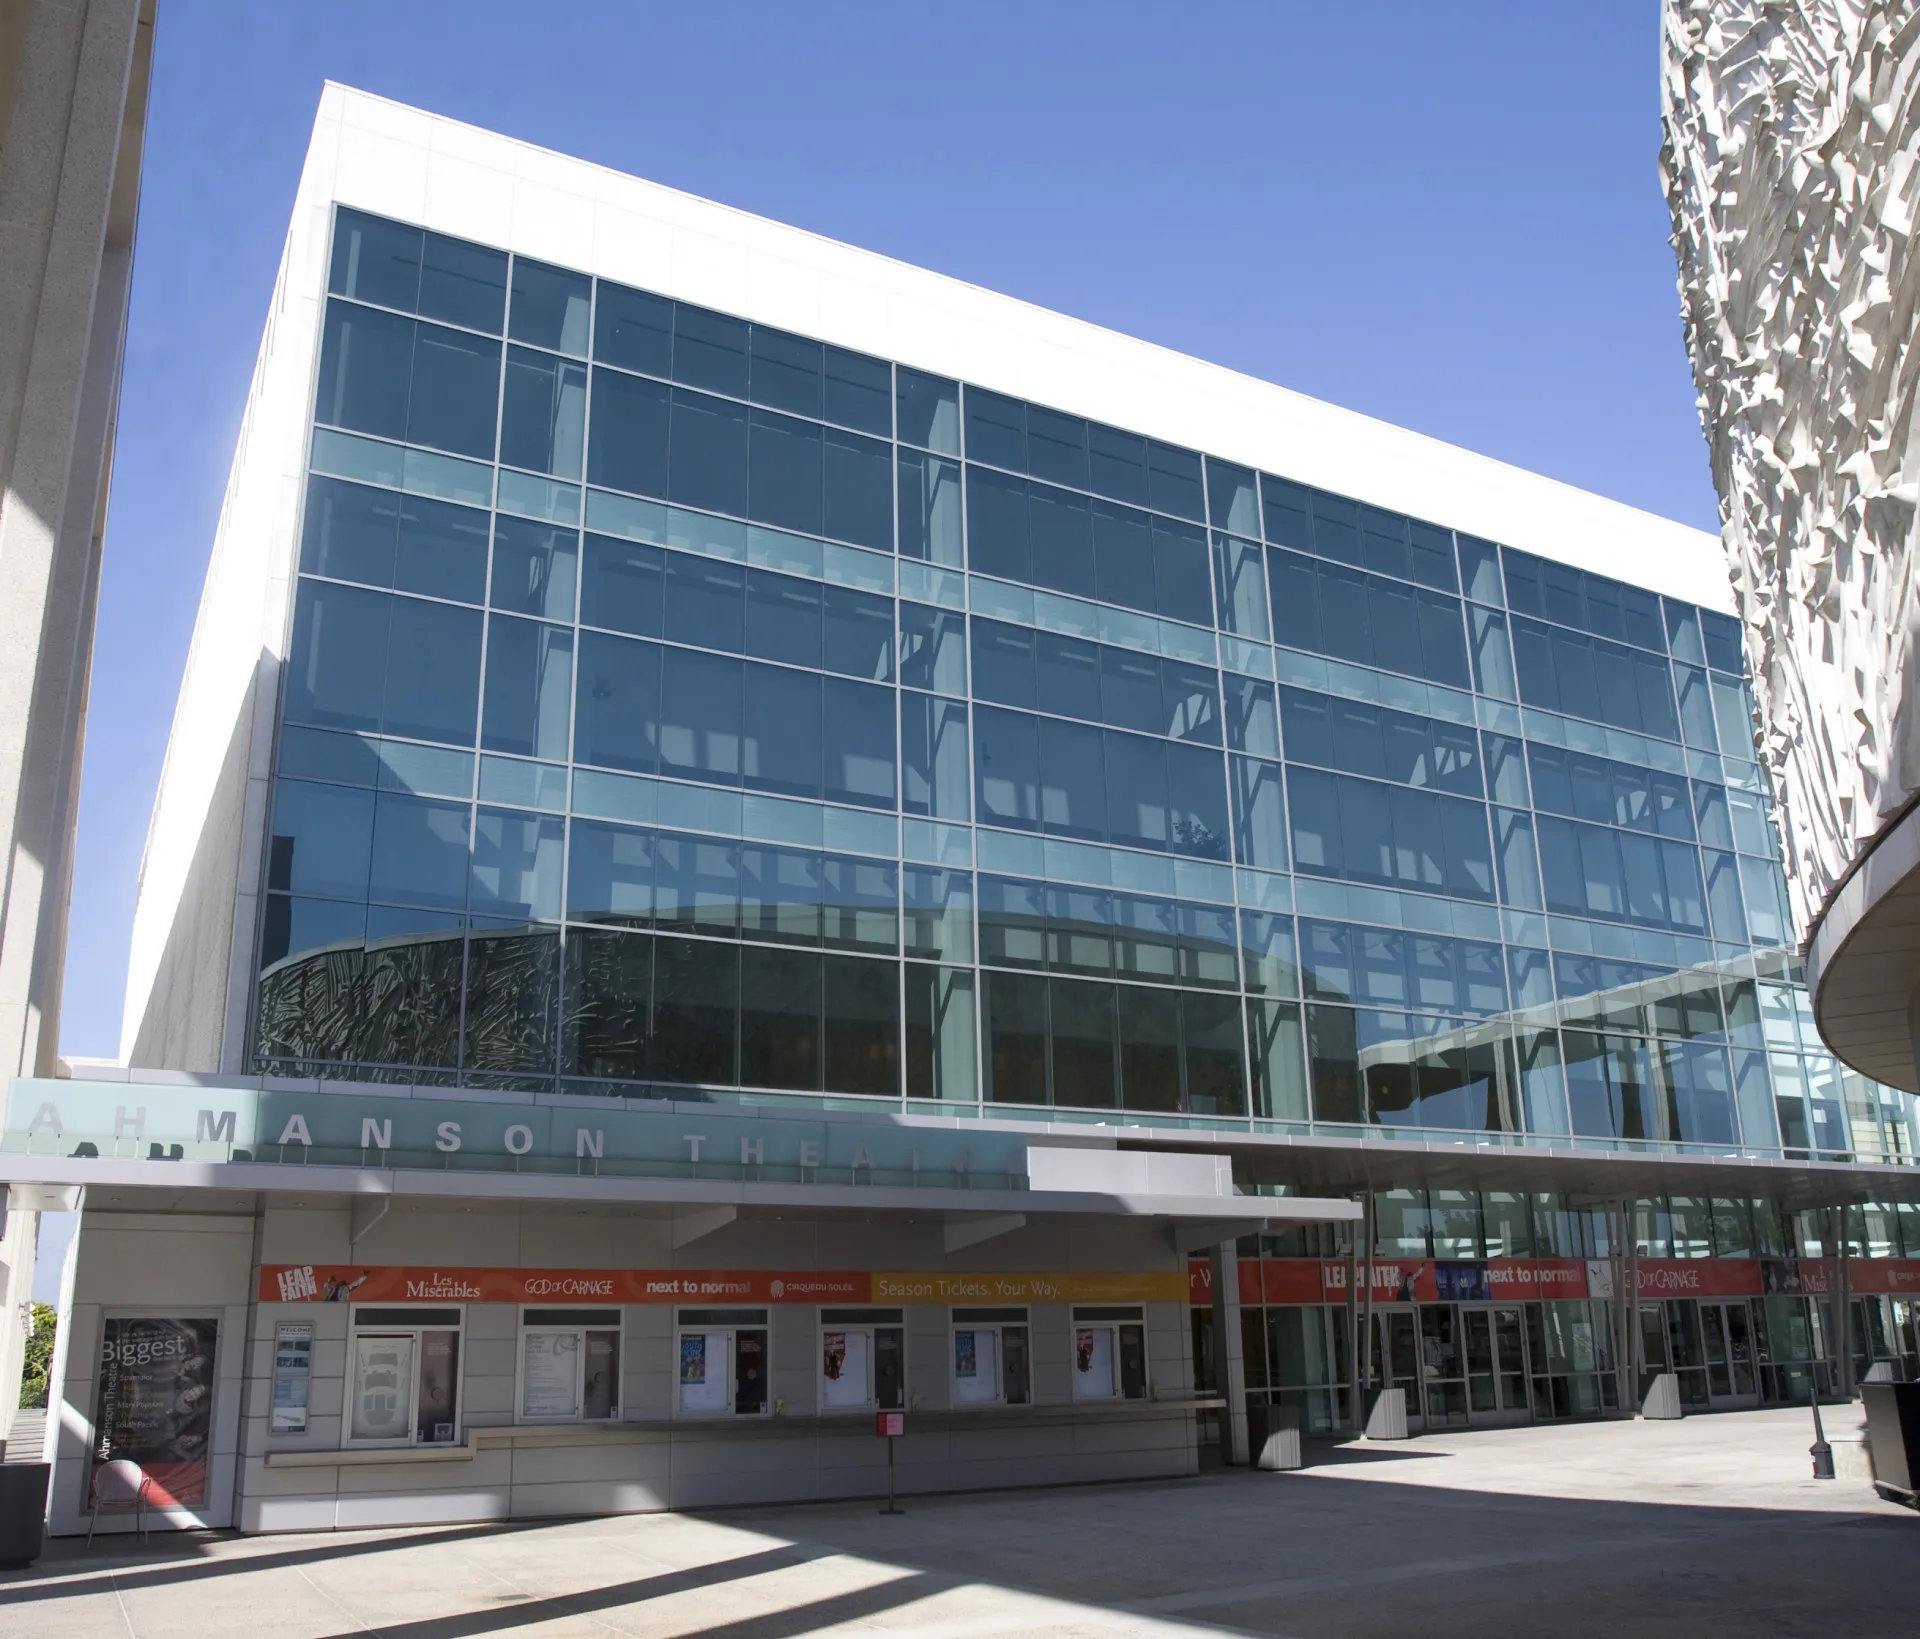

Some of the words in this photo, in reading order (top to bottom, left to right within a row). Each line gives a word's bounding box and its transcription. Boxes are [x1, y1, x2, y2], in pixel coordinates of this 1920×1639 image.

[29, 1101, 604, 1159] AHMANSON
[683, 1134, 1026, 1174] THEAT
[277, 1266, 314, 1289] LEAP
[433, 1272, 452, 1286] Les
[1483, 1267, 1514, 1284] next
[1516, 1266, 1532, 1283] to
[1535, 1266, 1581, 1283] normal
[1655, 1268, 1700, 1289] CARNAGE
[406, 1280, 481, 1298] Misérables
[524, 1278, 551, 1295] GOD
[562, 1278, 613, 1295] CARNAGE
[646, 1280, 678, 1294] next
[683, 1280, 698, 1294] to
[701, 1280, 750, 1294] normal
[879, 1280, 932, 1297] Season
[936, 1280, 991, 1297] Tickets.
[995, 1280, 1026, 1296] Your
[1030, 1280, 1061, 1298] Way.
[102, 1335, 187, 1366] Biggest
[104, 1362, 119, 1402] Theatre
[98, 1403, 114, 1460] Ahmanson
